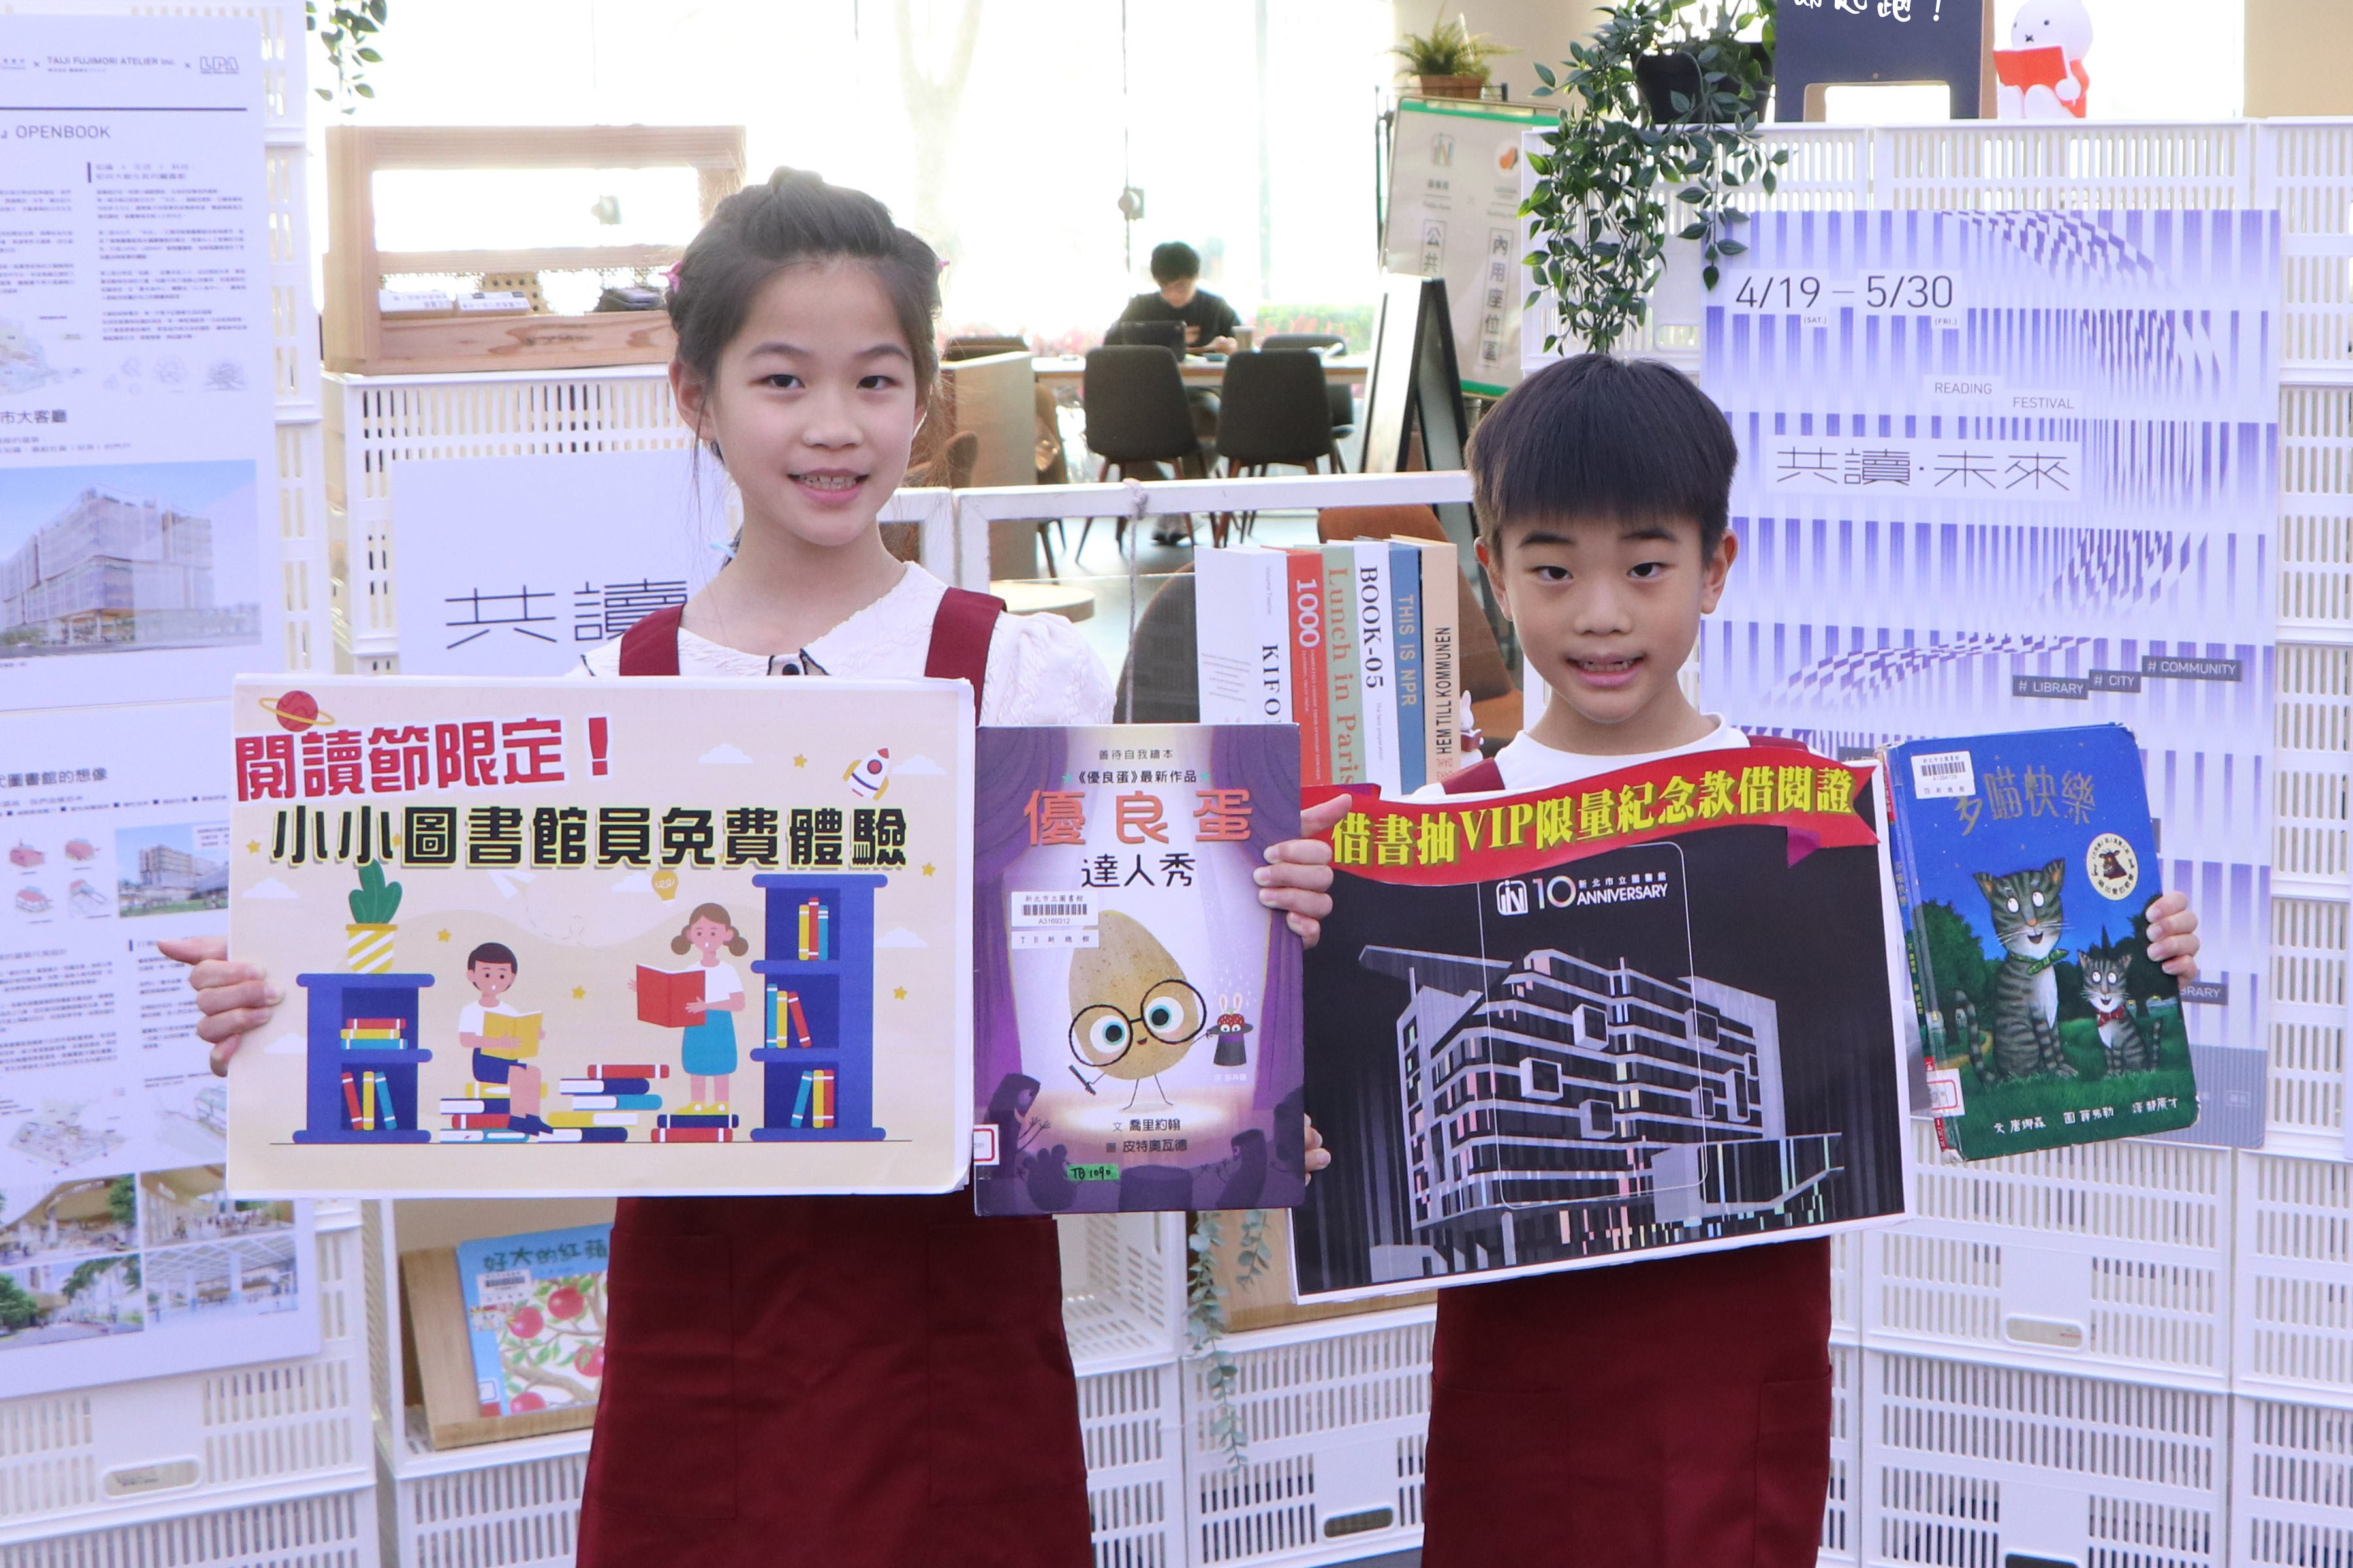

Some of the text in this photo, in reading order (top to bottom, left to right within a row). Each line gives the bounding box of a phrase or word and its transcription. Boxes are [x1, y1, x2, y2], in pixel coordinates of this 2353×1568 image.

[16, 125, 111, 138] OPENBOOK
[1735, 275, 1954, 309] 4/19 5/30
[1803, 316, 1827, 324] (SAT.)
[1934, 382, 1992, 395] READING
[2013, 397, 2075, 409] FESTIVAL
[445, 578, 687, 649] 共讀
[1296, 579, 1320, 648] 1000
[1360, 566, 1384, 689] BOOK-05
[1397, 594, 1417, 707] THIS IS NPR
[1436, 626, 1452, 698] KOMMUNEN
[1262, 644, 1282, 724] KIFO
[1328, 568, 1359, 784] Lunch in Paris
[2109, 675, 2135, 686] CITY
[2161, 661, 2236, 675] COMMUNITY
[2033, 683, 2084, 694] LIBRARY
[1436, 700, 1452, 726] TILL
[1099, 749, 1174, 760] 善待自我繪本
[1436, 728, 1452, 754] HEM
[235, 716, 608, 802] 閱讀節限定！
[1078, 770, 1197, 784] 《優良蛋》最新作品
[1023, 789, 1253, 846] 優良蛋
[1332, 765, 1854, 867] 借書抽VIP限量紀念款借閱證
[272, 805, 907, 869] 小小圖書館員免費體驗
[1081, 852, 1196, 888] 達人秀
[1533, 875, 1668, 909] 10 ANNIVERSARY
[1112, 1118, 1181, 1131] 文 喬里約翰
[1123, 1139, 1188, 1153] 皮特奧瓦德
